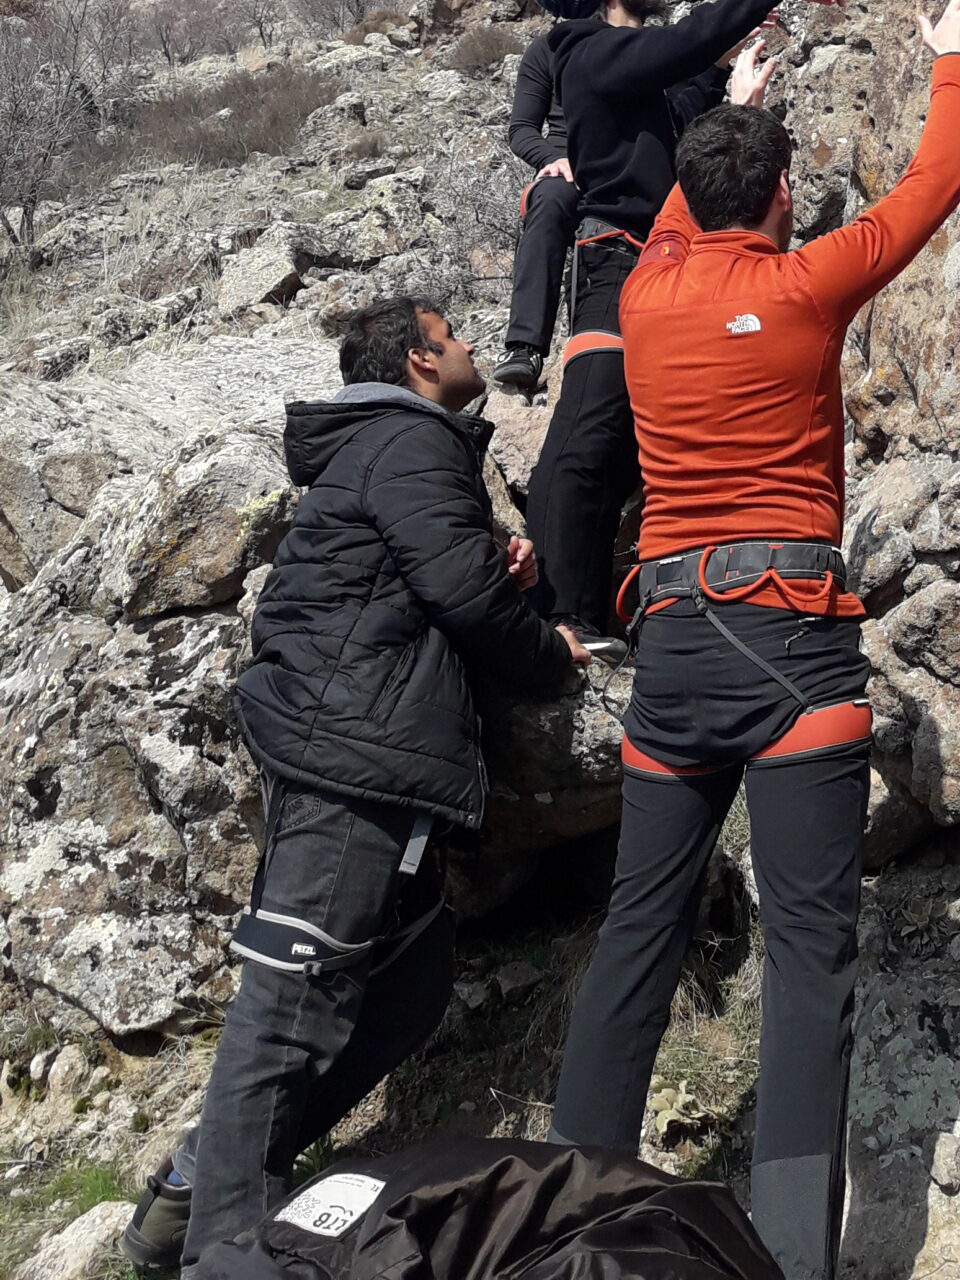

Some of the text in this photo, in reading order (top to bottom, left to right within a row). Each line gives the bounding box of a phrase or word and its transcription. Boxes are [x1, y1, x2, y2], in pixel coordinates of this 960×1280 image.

[726, 320, 749, 329] NORTH
[732, 326, 750, 334] FACE
[291, 942, 317, 955] PETZL
[312, 1212, 349, 1231] LTB
